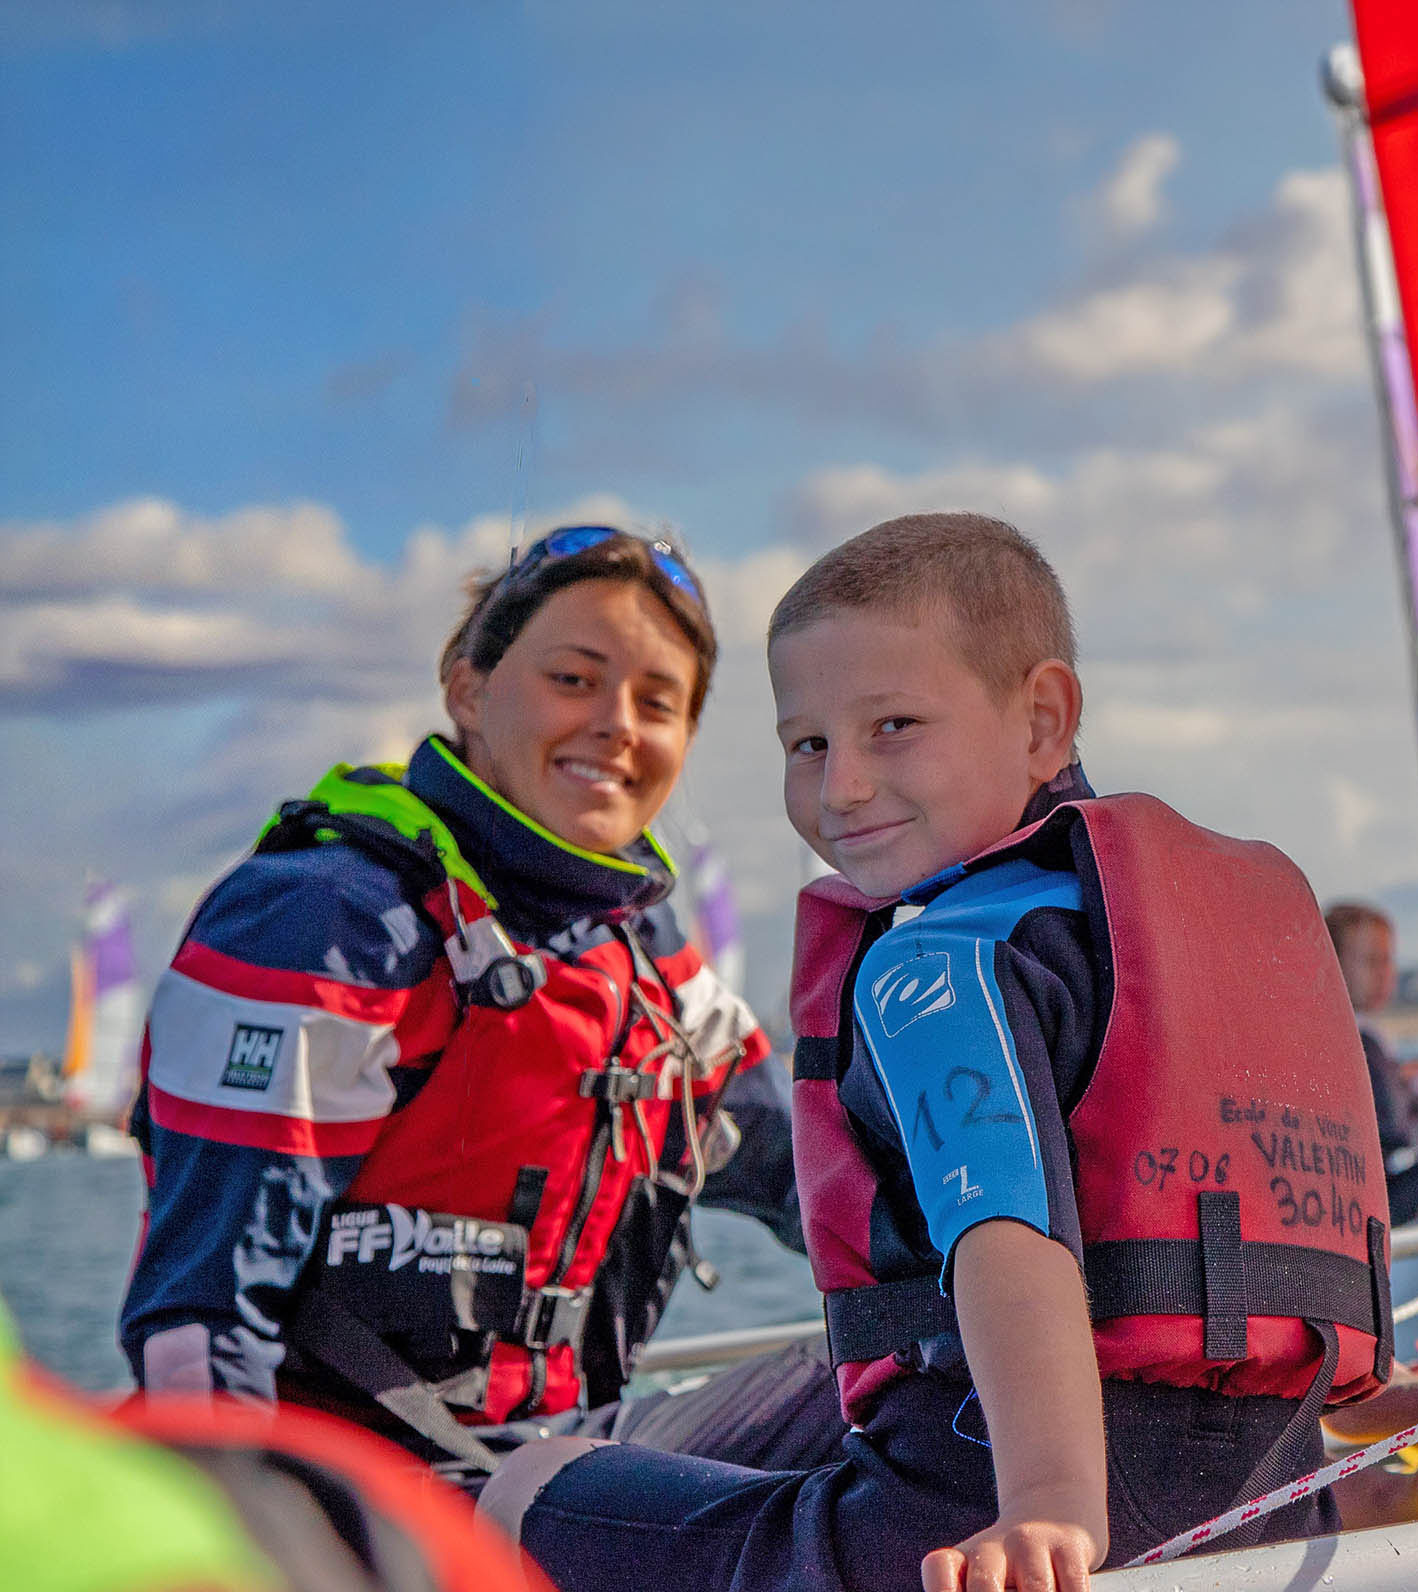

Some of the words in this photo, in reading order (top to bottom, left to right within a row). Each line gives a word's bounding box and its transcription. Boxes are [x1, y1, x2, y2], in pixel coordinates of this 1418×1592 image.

[231, 1029, 281, 1067] HH
[911, 1066, 1023, 1151] 12
[1251, 1131, 1366, 1184] VALENTIN
[957, 1188, 984, 1207] LARGE
[959, 1164, 979, 1195] L
